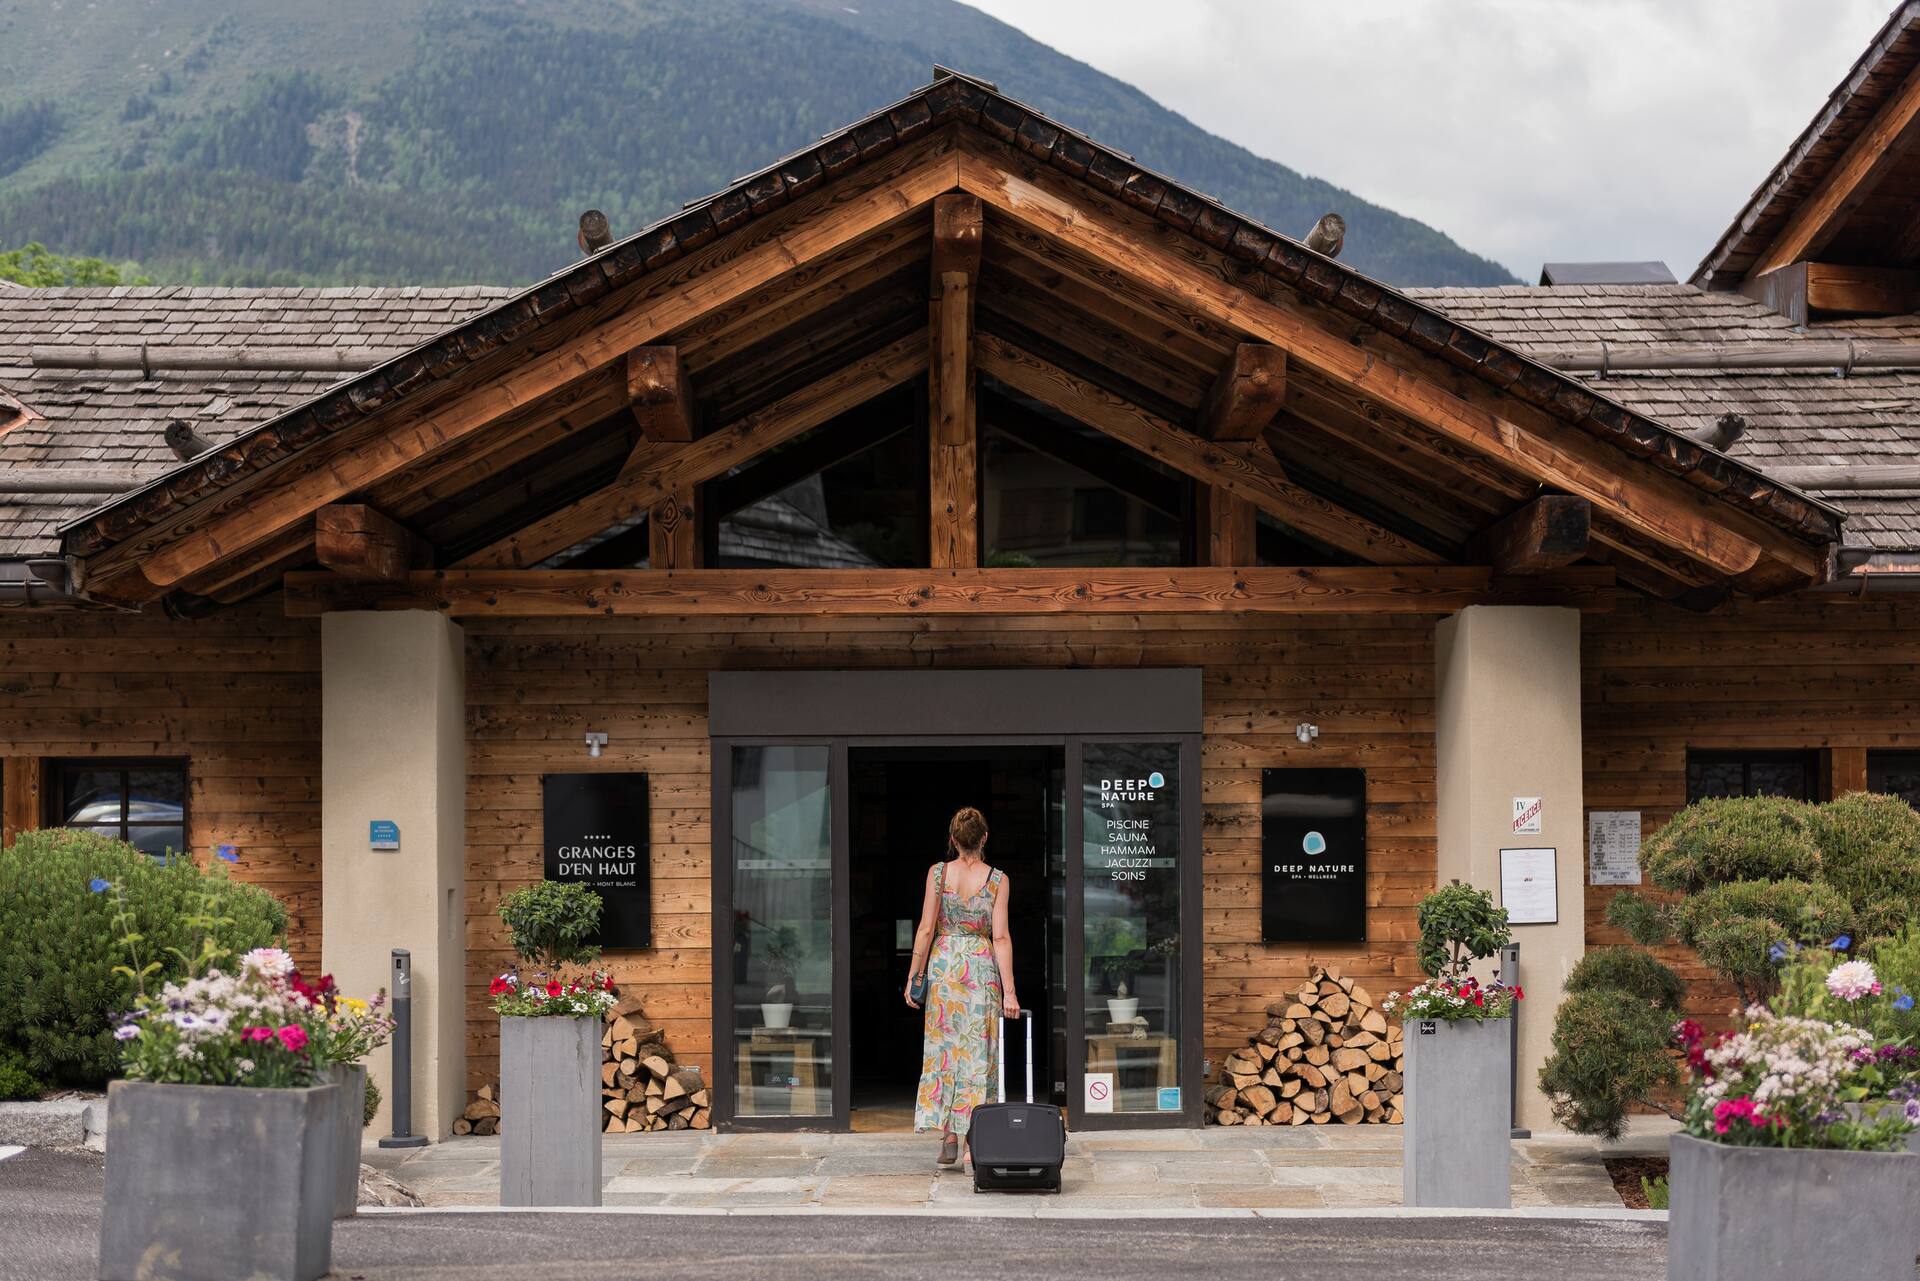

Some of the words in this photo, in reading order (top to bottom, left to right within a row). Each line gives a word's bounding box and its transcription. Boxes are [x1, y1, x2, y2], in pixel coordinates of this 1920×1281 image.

[1101, 779, 1147, 791] DEEP
[1101, 792, 1154, 801] NATURE
[1516, 801, 1526, 811] IV
[1514, 800, 1541, 830] LICENCE
[1106, 819, 1150, 830] PISCINE
[1108, 833, 1149, 842] SAUNA
[558, 846, 636, 859] GRANGES
[1101, 845, 1156, 855] HAMMAM
[1104, 858, 1152, 868] JACUZZI
[559, 863, 593, 875] D'EN
[599, 862, 637, 875] HAUT
[1274, 865, 1303, 873] DEEP
[1309, 865, 1355, 873] NATURE
[1111, 871, 1146, 881] SOINS
